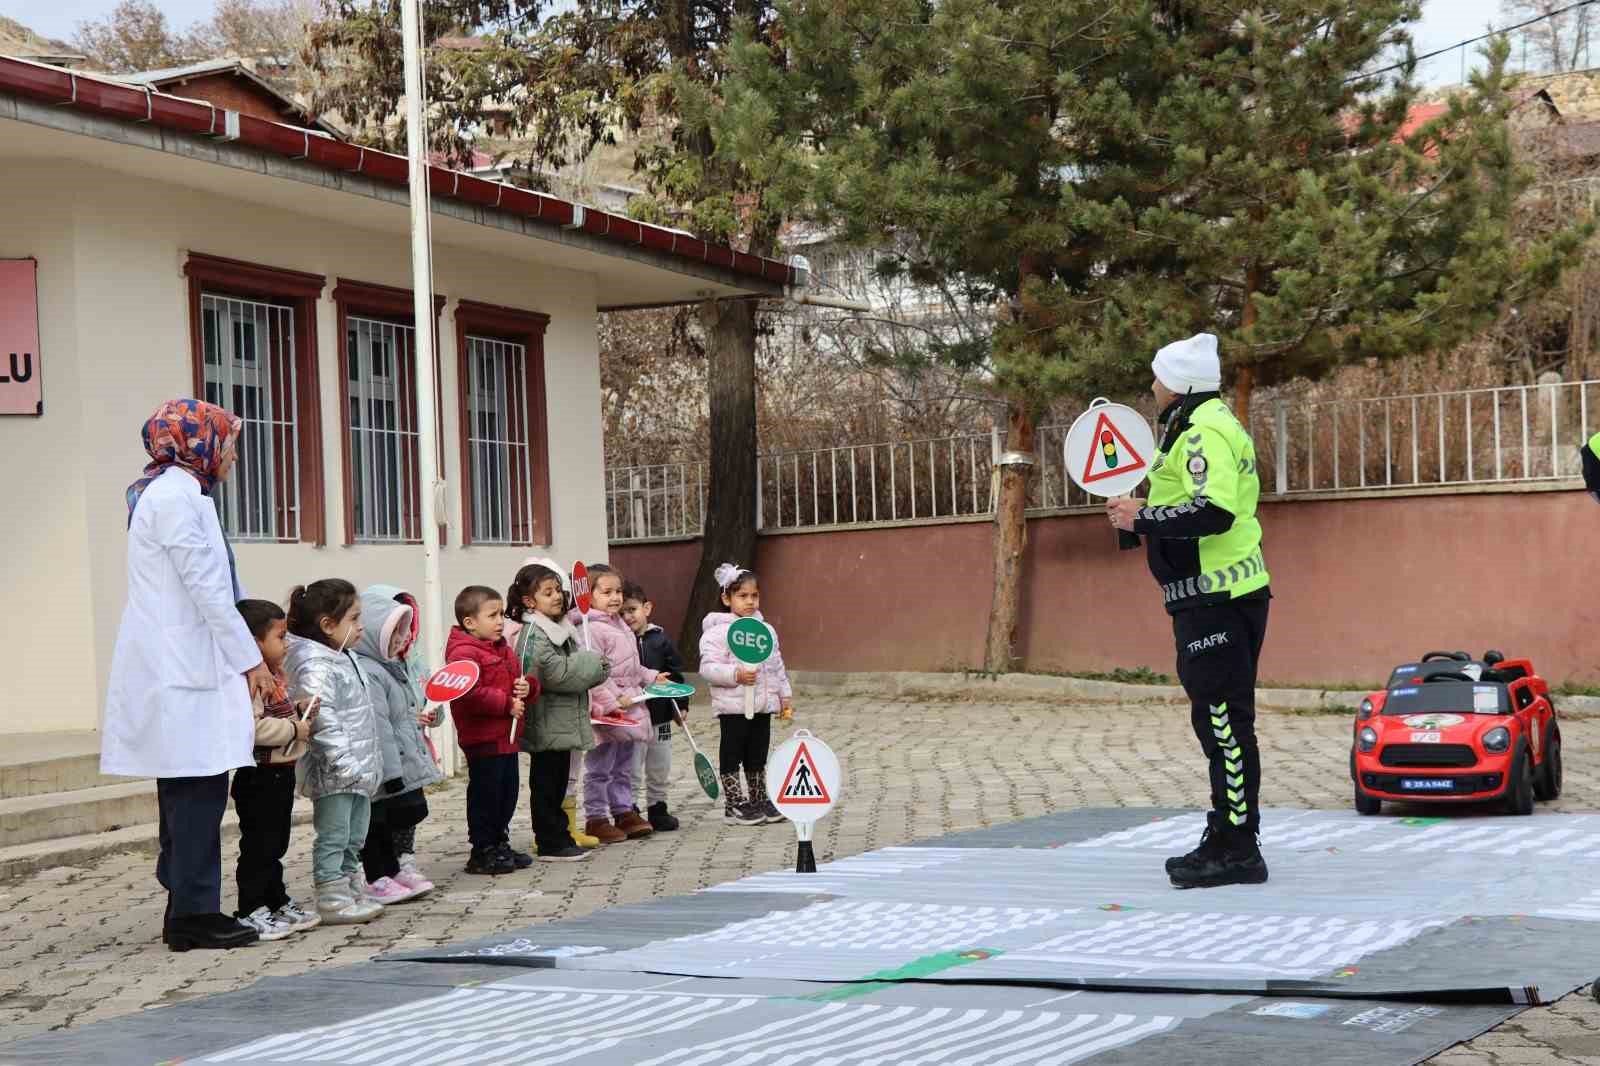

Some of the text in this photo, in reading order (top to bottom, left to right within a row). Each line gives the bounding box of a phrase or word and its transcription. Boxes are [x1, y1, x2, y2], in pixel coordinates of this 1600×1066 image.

[574, 576, 590, 596] DUR
[732, 630, 768, 654] GEÇ
[431, 671, 471, 691] DUR
